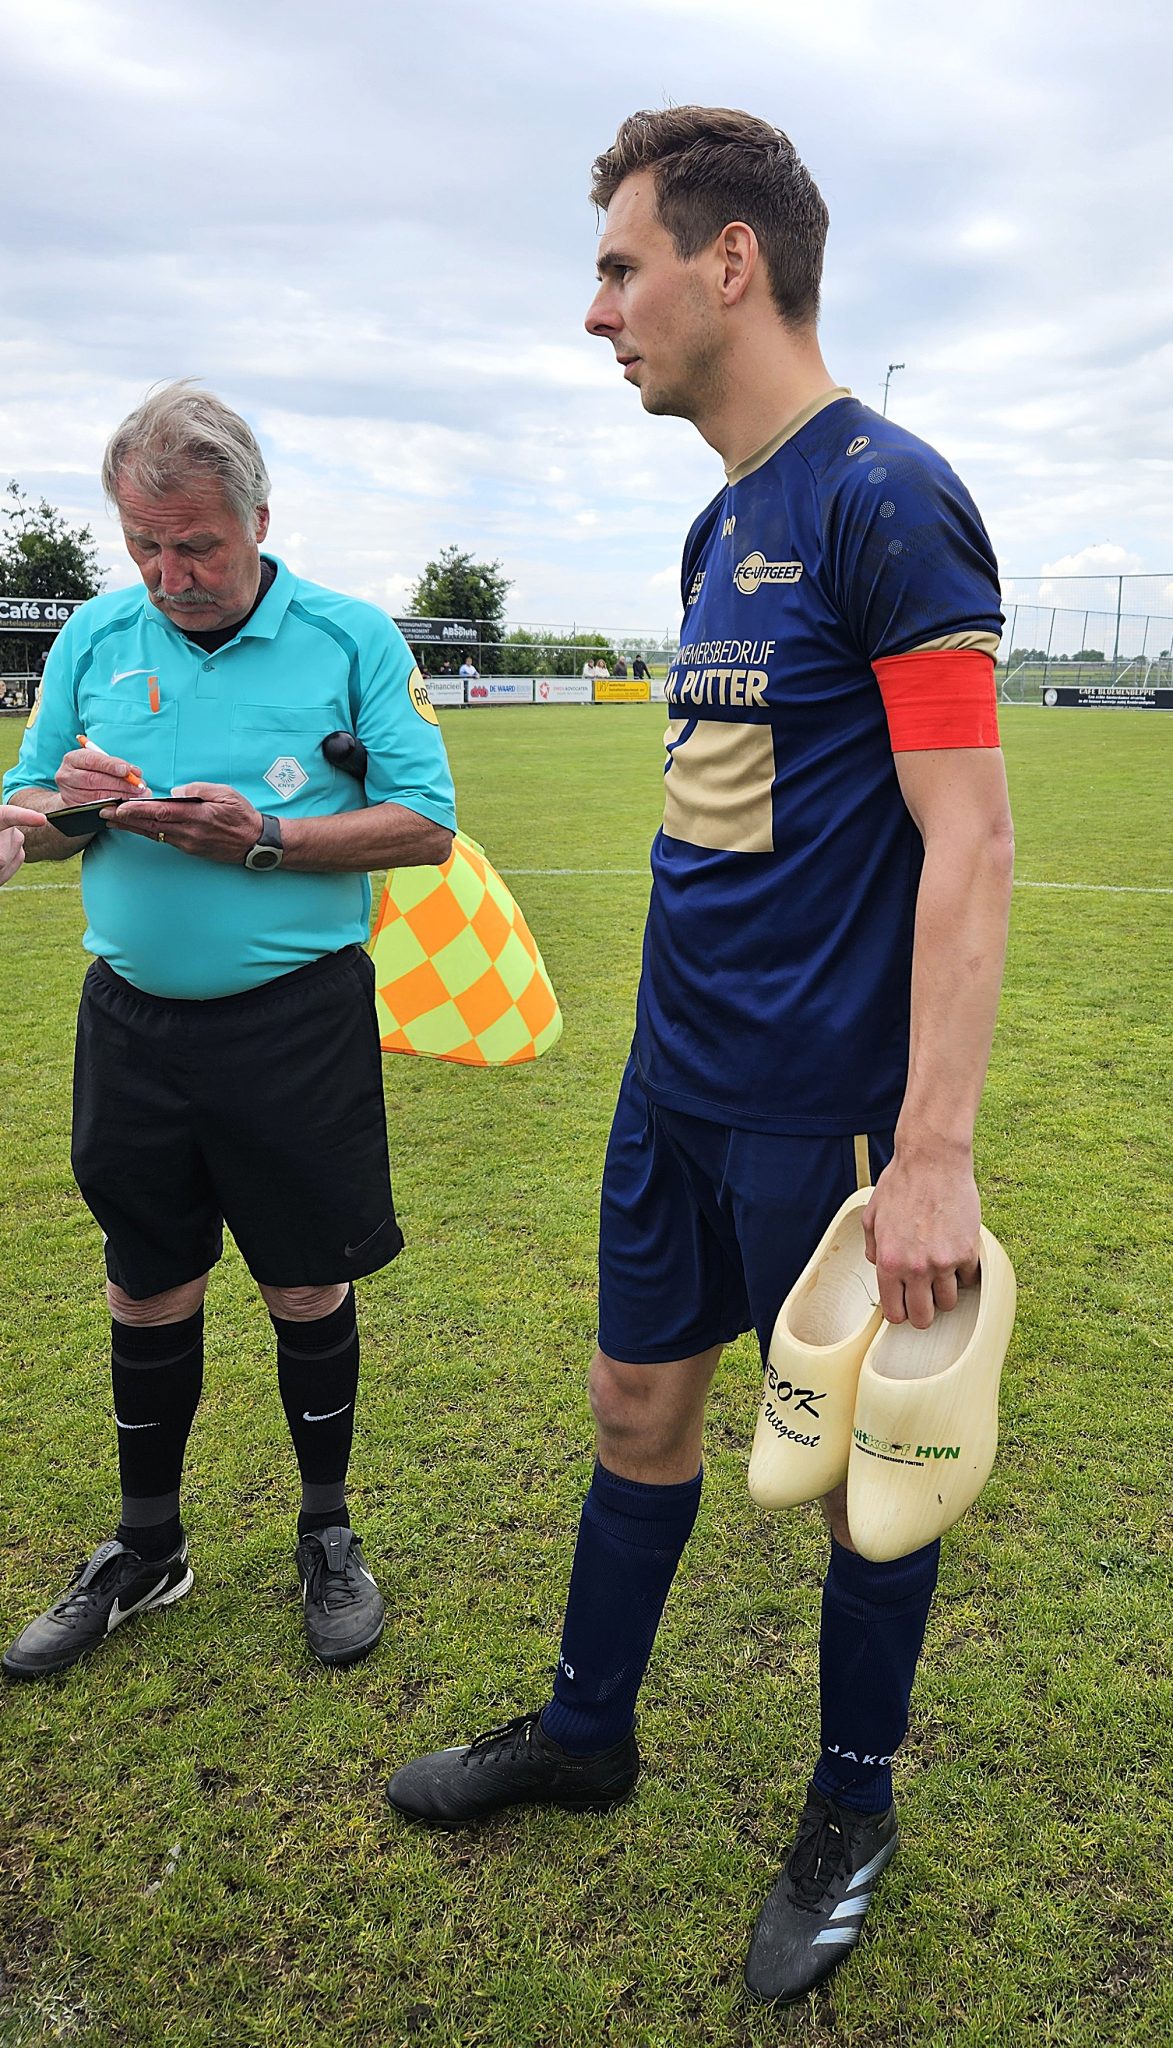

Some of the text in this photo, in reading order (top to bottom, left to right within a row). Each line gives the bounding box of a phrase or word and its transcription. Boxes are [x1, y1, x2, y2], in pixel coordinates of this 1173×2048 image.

[0, 602, 40, 619] Café
[44, 603, 69, 620] de
[414, 687, 431, 706] AR
[681, 668, 770, 707] PUTTER
[765, 1402, 821, 1447] Uitgeest
[915, 1445, 960, 1459] HVN
[827, 1744, 894, 1766] JAKO
